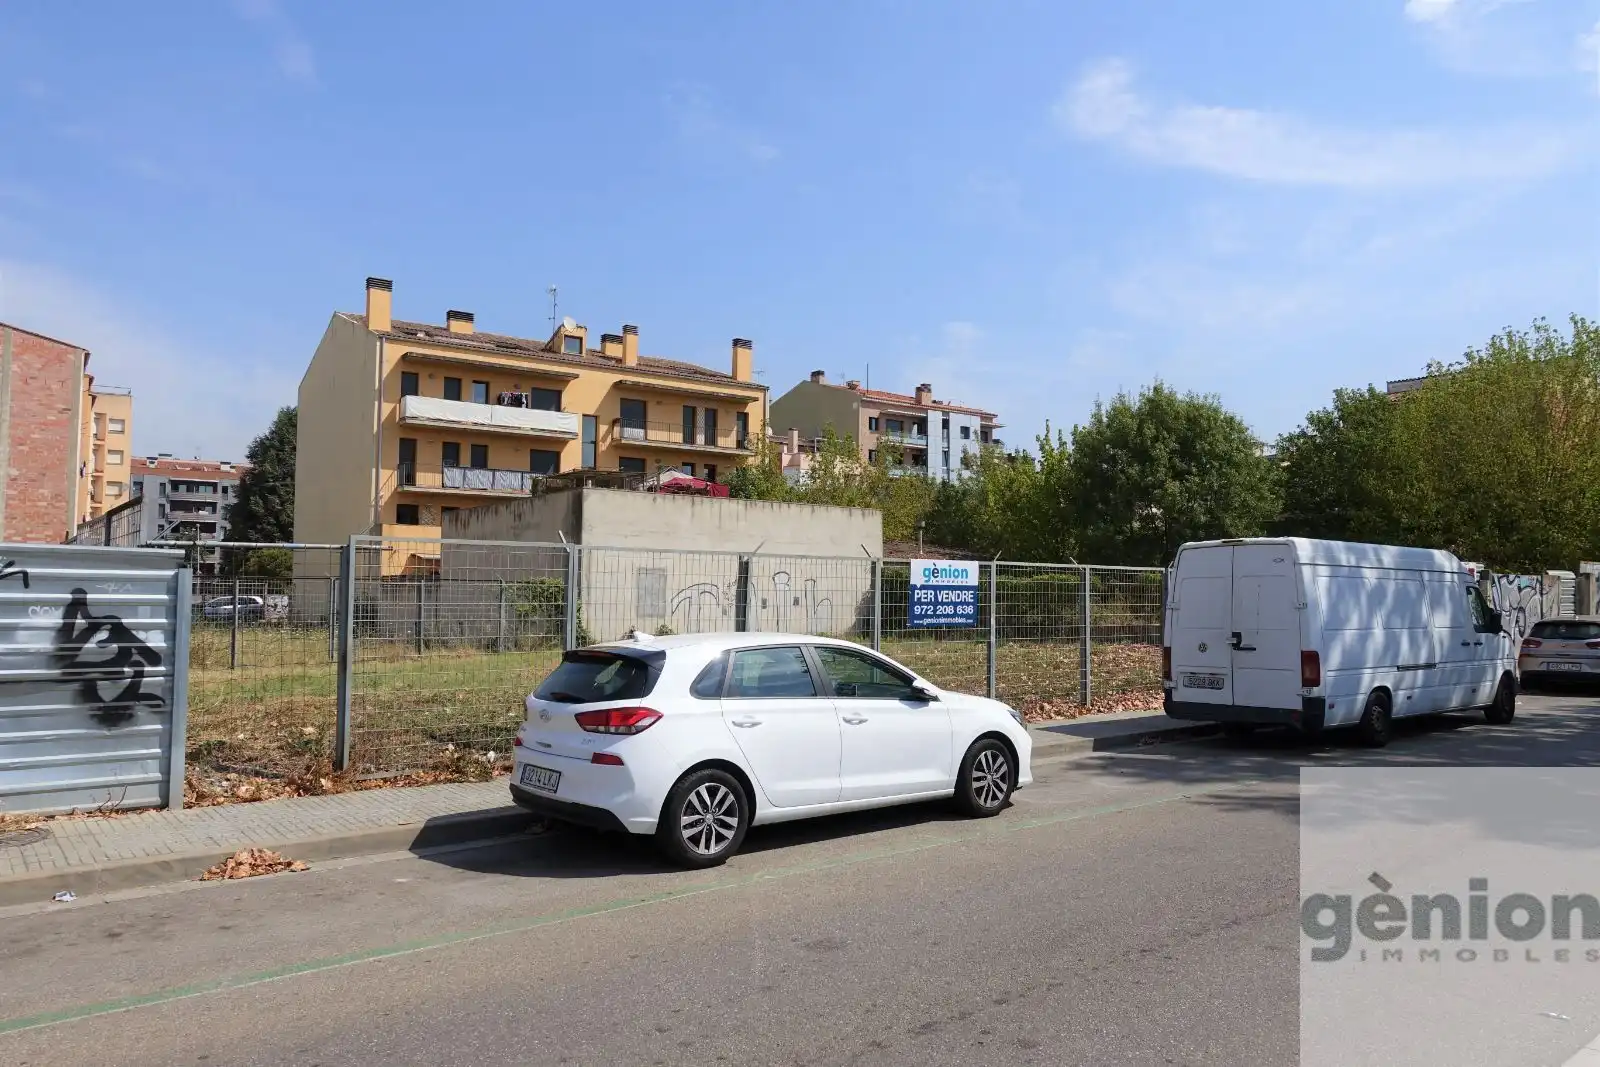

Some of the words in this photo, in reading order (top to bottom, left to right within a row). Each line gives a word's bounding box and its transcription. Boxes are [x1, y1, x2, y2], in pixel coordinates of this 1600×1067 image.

[922, 562, 969, 583] gènion
[914, 590, 935, 602] PER
[937, 590, 974, 602] VENDRE
[914, 605, 934, 615] 972
[936, 605, 954, 615] 208
[956, 605, 974, 615] 636
